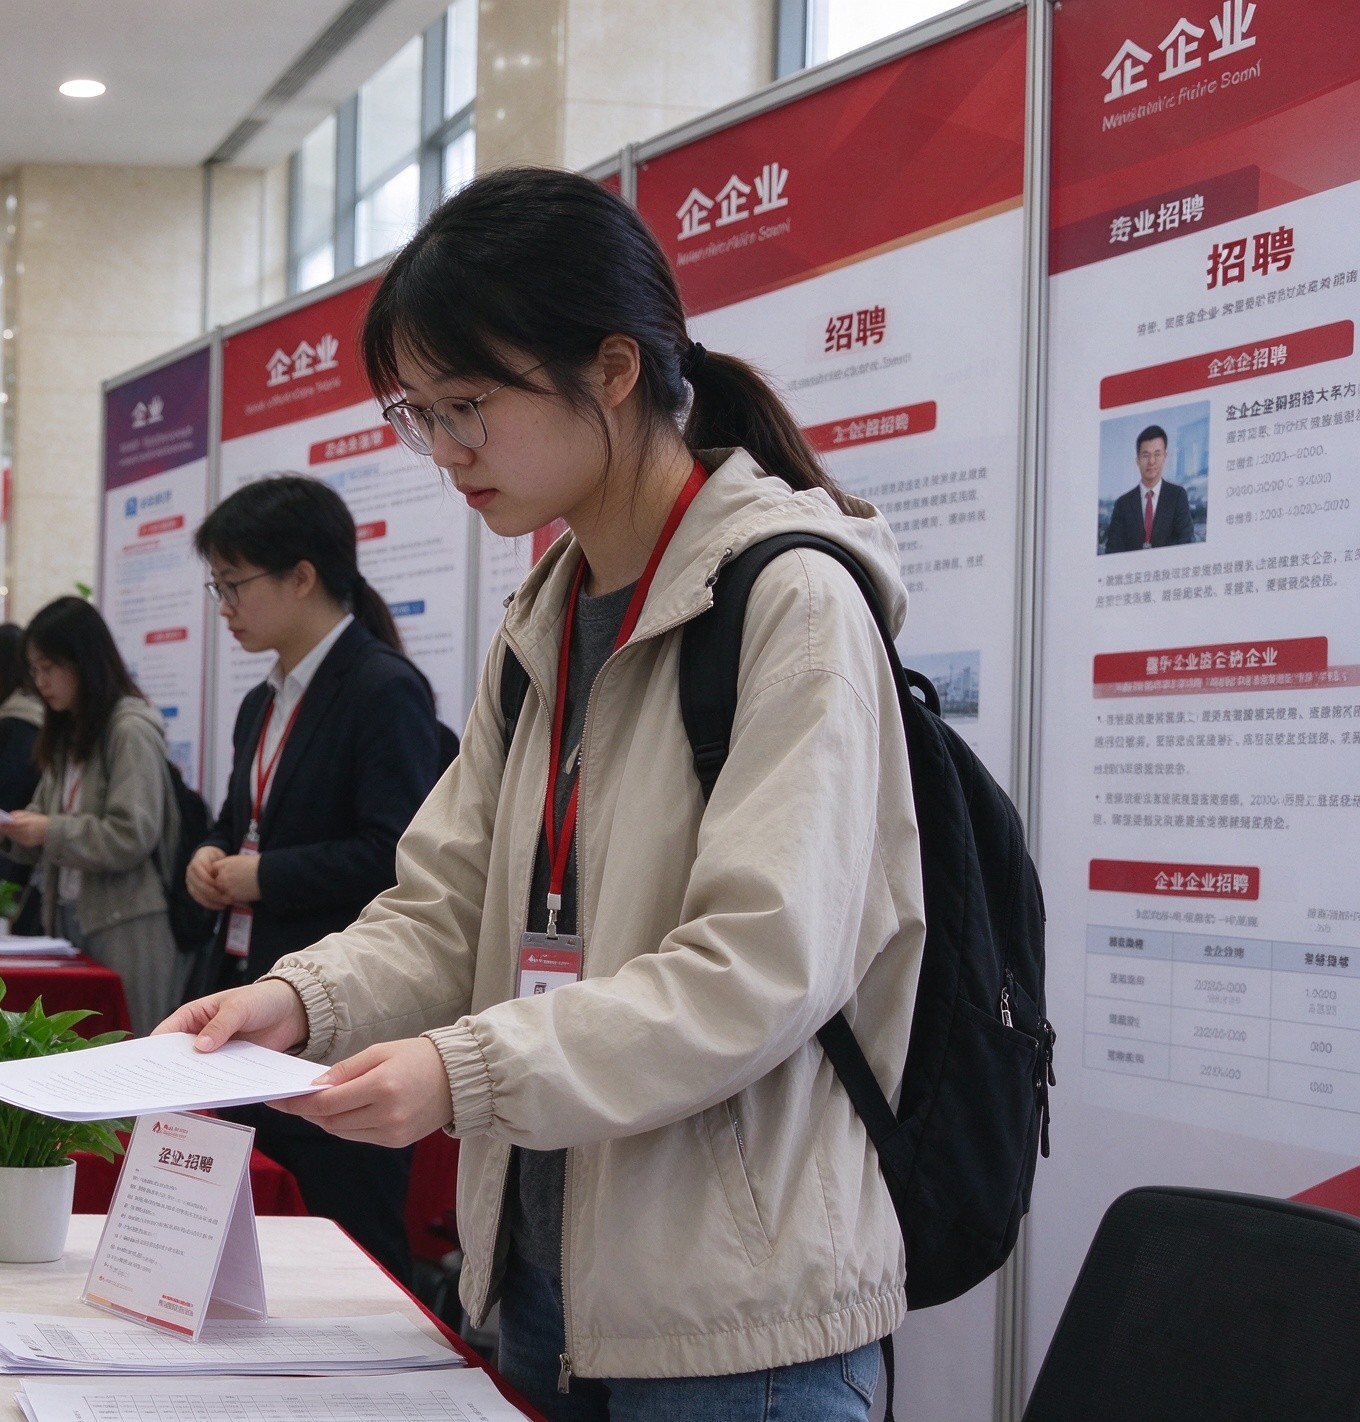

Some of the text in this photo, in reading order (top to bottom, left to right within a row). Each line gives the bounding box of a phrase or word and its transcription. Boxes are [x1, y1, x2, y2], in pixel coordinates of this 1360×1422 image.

[1101, 0, 1256, 103] 企企业
[675, 162, 790, 242] 企企业
[1206, 225, 1295, 290] 招聘
[265, 332, 339, 388] 企企业
[1154, 871, 1249, 894] 企业企业招聘
